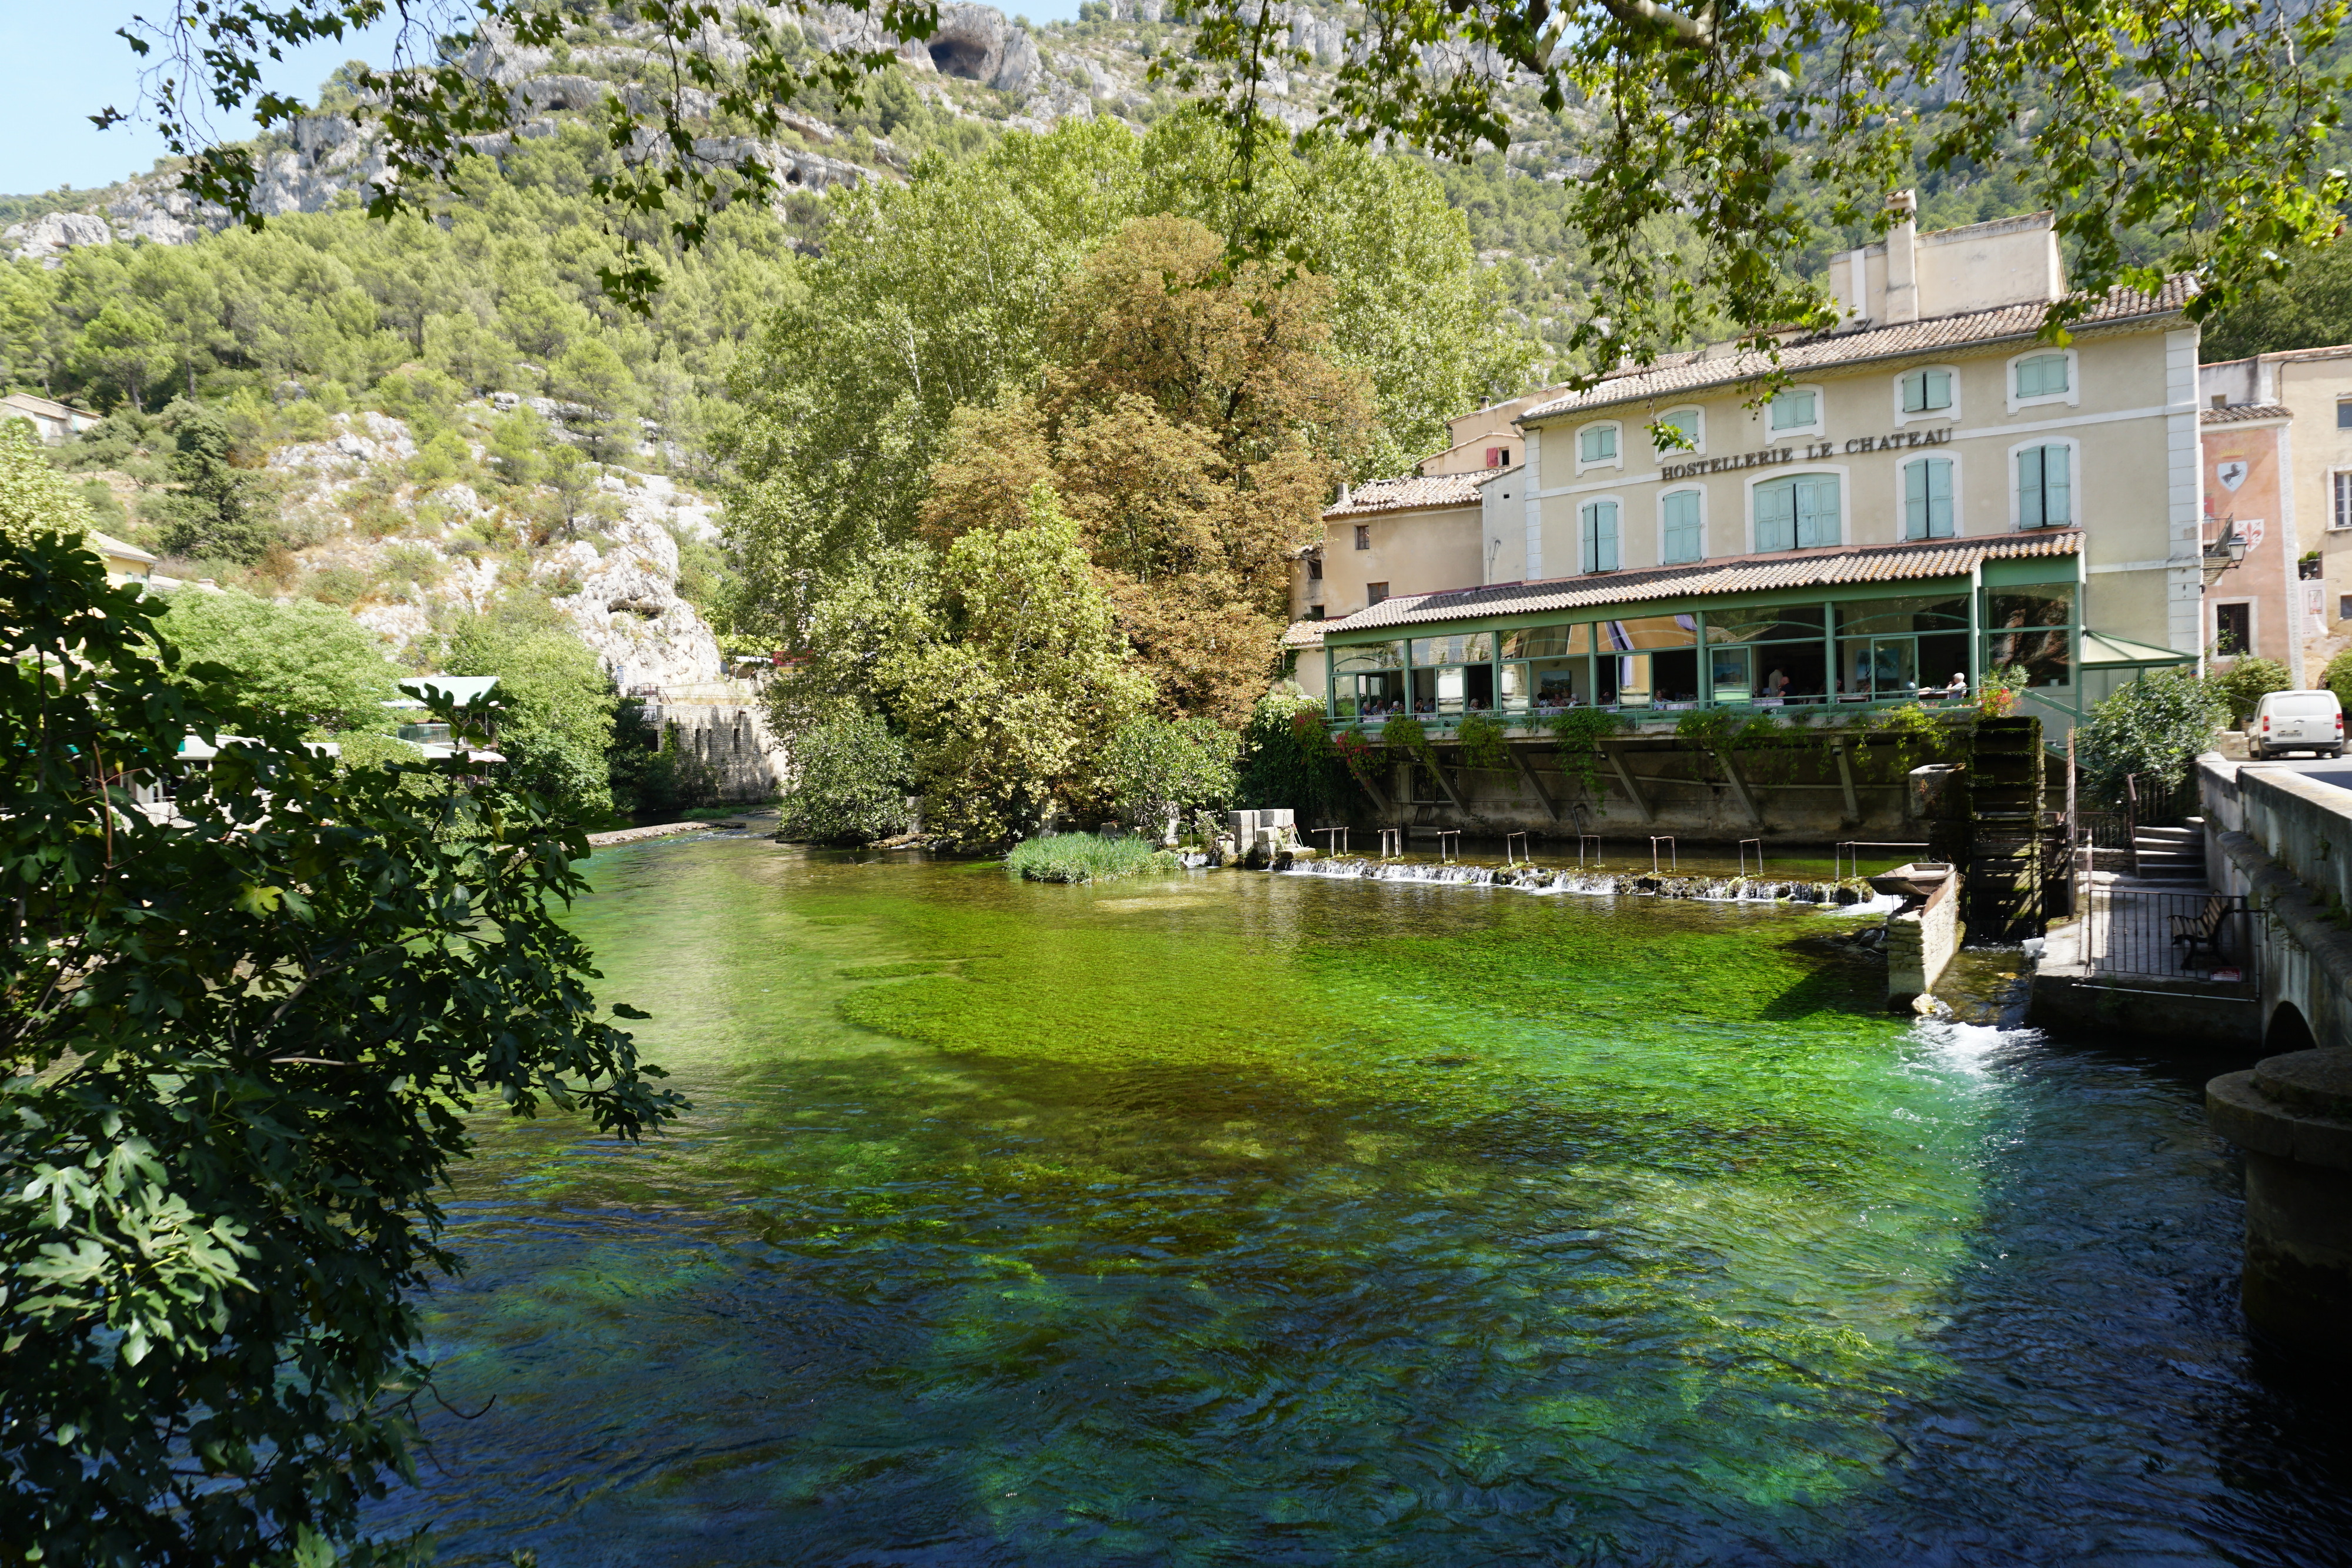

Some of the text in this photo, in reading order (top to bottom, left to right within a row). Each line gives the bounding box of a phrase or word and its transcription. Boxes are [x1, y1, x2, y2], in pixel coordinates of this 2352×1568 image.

[1661, 427, 1953, 480] HOSTELLERIE LE CHATEAU
